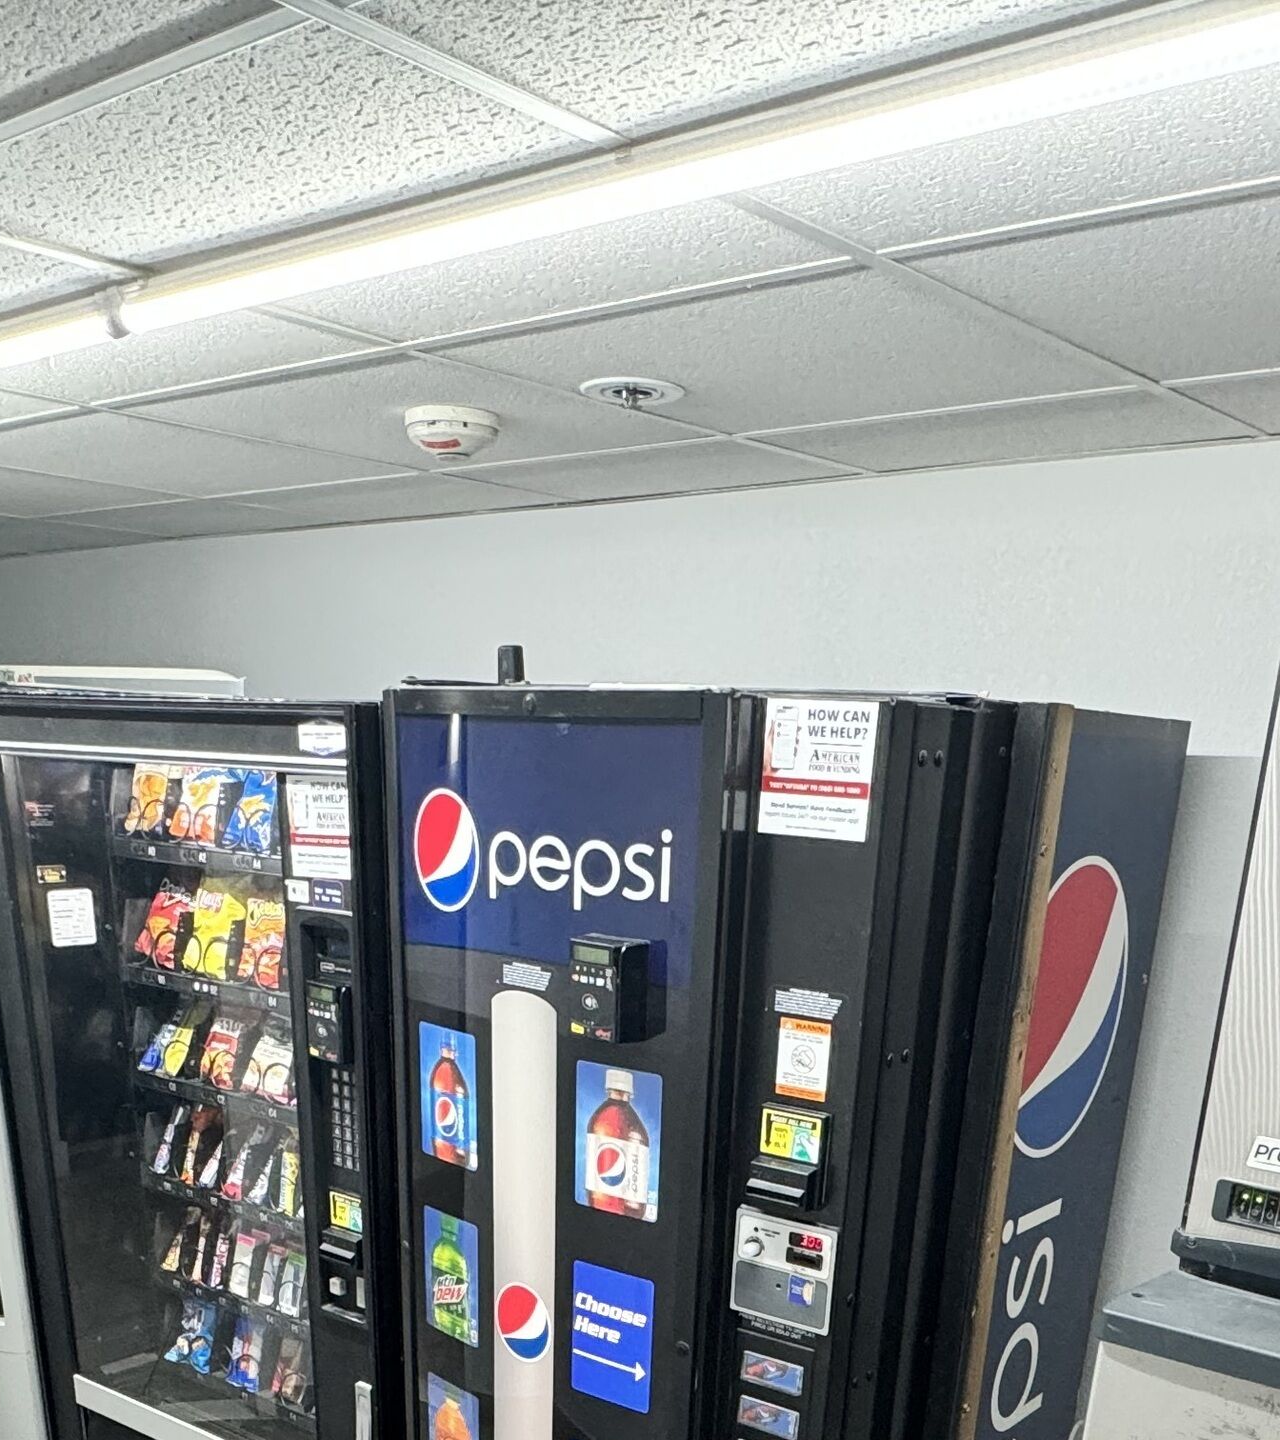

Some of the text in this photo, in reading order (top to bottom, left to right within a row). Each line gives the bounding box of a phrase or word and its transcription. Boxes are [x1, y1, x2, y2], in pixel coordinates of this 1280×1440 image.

[807, 709, 871, 723] HOW CAN
[807, 725, 868, 740] WE HELP?
[809, 749, 860, 763] AMERICAN
[489, 829, 673, 911] pepsi
[576, 1292, 647, 1328] Choose
[575, 1315, 620, 1343] Here
